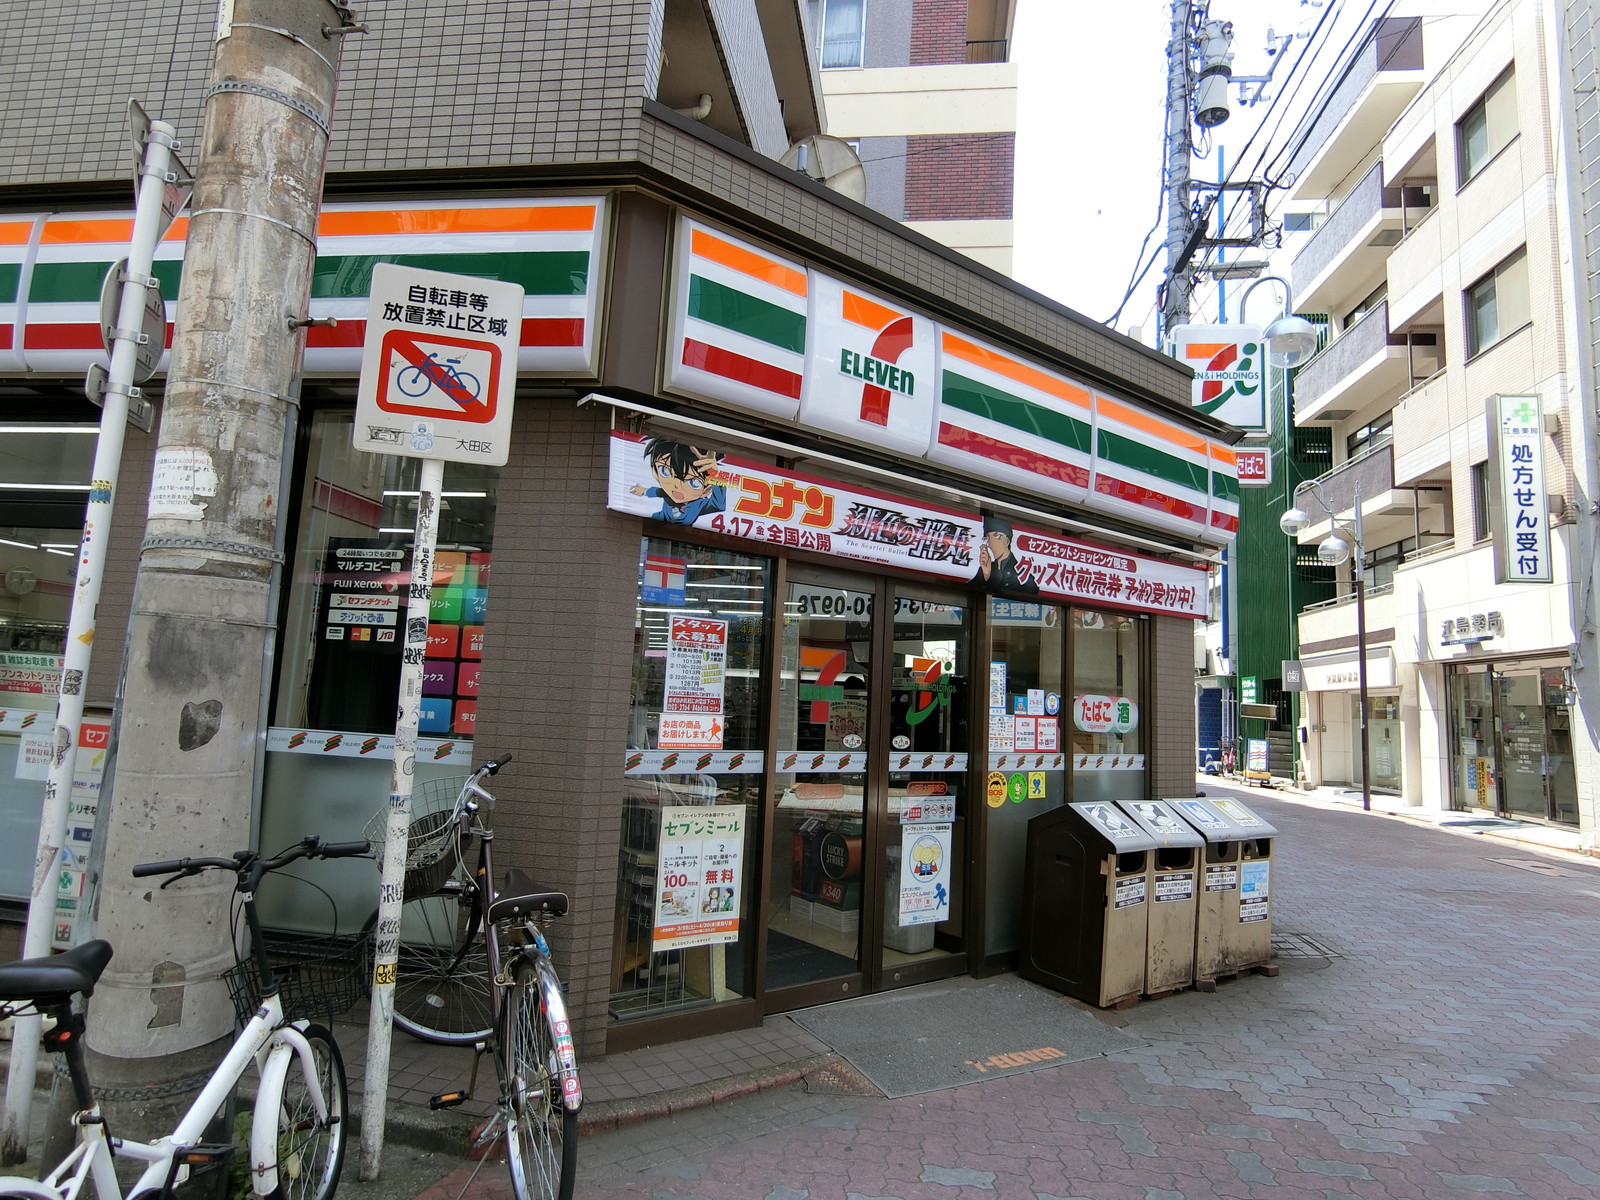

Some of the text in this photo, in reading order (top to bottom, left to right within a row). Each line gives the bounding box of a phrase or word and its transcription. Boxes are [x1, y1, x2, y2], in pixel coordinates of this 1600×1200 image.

[408, 285, 489, 313] 自転車等
[382, 301, 509, 337] 放置禁止区域
[1216, 372, 1260, 380] HOLDINGS
[455, 439, 493, 454] 大田区
[1236, 456, 1265, 476] たばこ
[733, 476, 836, 530] コナン
[1511, 444, 1540, 576] 処方せん受付
[711, 513, 754, 538] 4.17
[766, 523, 833, 553] 全国公開
[342, 550, 398, 558] 24時間いつでも便利
[1027, 537, 1129, 571] セブンネットショッピング限定
[336, 561, 402, 573] マルチコピー機
[333, 580, 383, 589] FUJI xerox
[1014, 555, 1196, 610] グッズ付前売券 予約受付中!
[347, 596, 393, 606] セブンチケット
[673, 618, 725, 631] スタッフ
[378, 631, 394, 641] JTB
[426, 636, 448, 644] キャン
[675, 630, 721, 643] 大募集
[423, 673, 444, 682] ァクス
[1286, 670, 1300, 682] 歯
[1081, 699, 1112, 722] たばこ
[1116, 702, 1130, 724] 酒
[663, 720, 701, 729] お店の商品
[664, 820, 741, 837] セブンミール
[828, 844, 844, 858] LUCKY
[663, 860, 698, 869] ミールキット
[826, 854, 844, 867] STRIKE
[663, 874, 688, 888] 100
[705, 868, 734, 885] 無料
